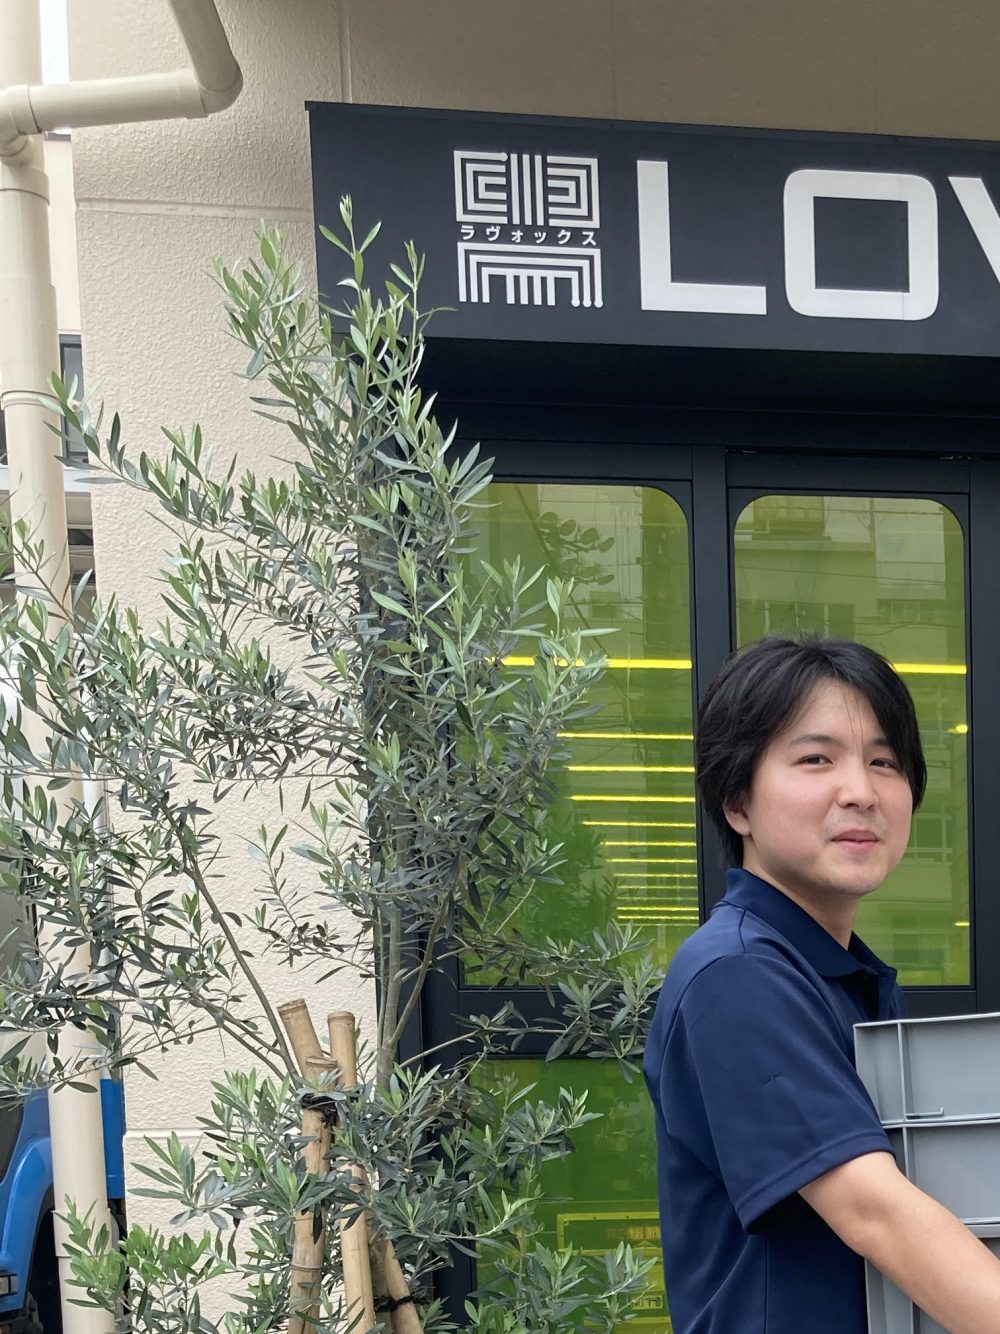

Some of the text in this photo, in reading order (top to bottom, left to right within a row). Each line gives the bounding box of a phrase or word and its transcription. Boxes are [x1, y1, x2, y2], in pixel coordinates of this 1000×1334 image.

[460, 225, 598, 246] ラヴォックス
